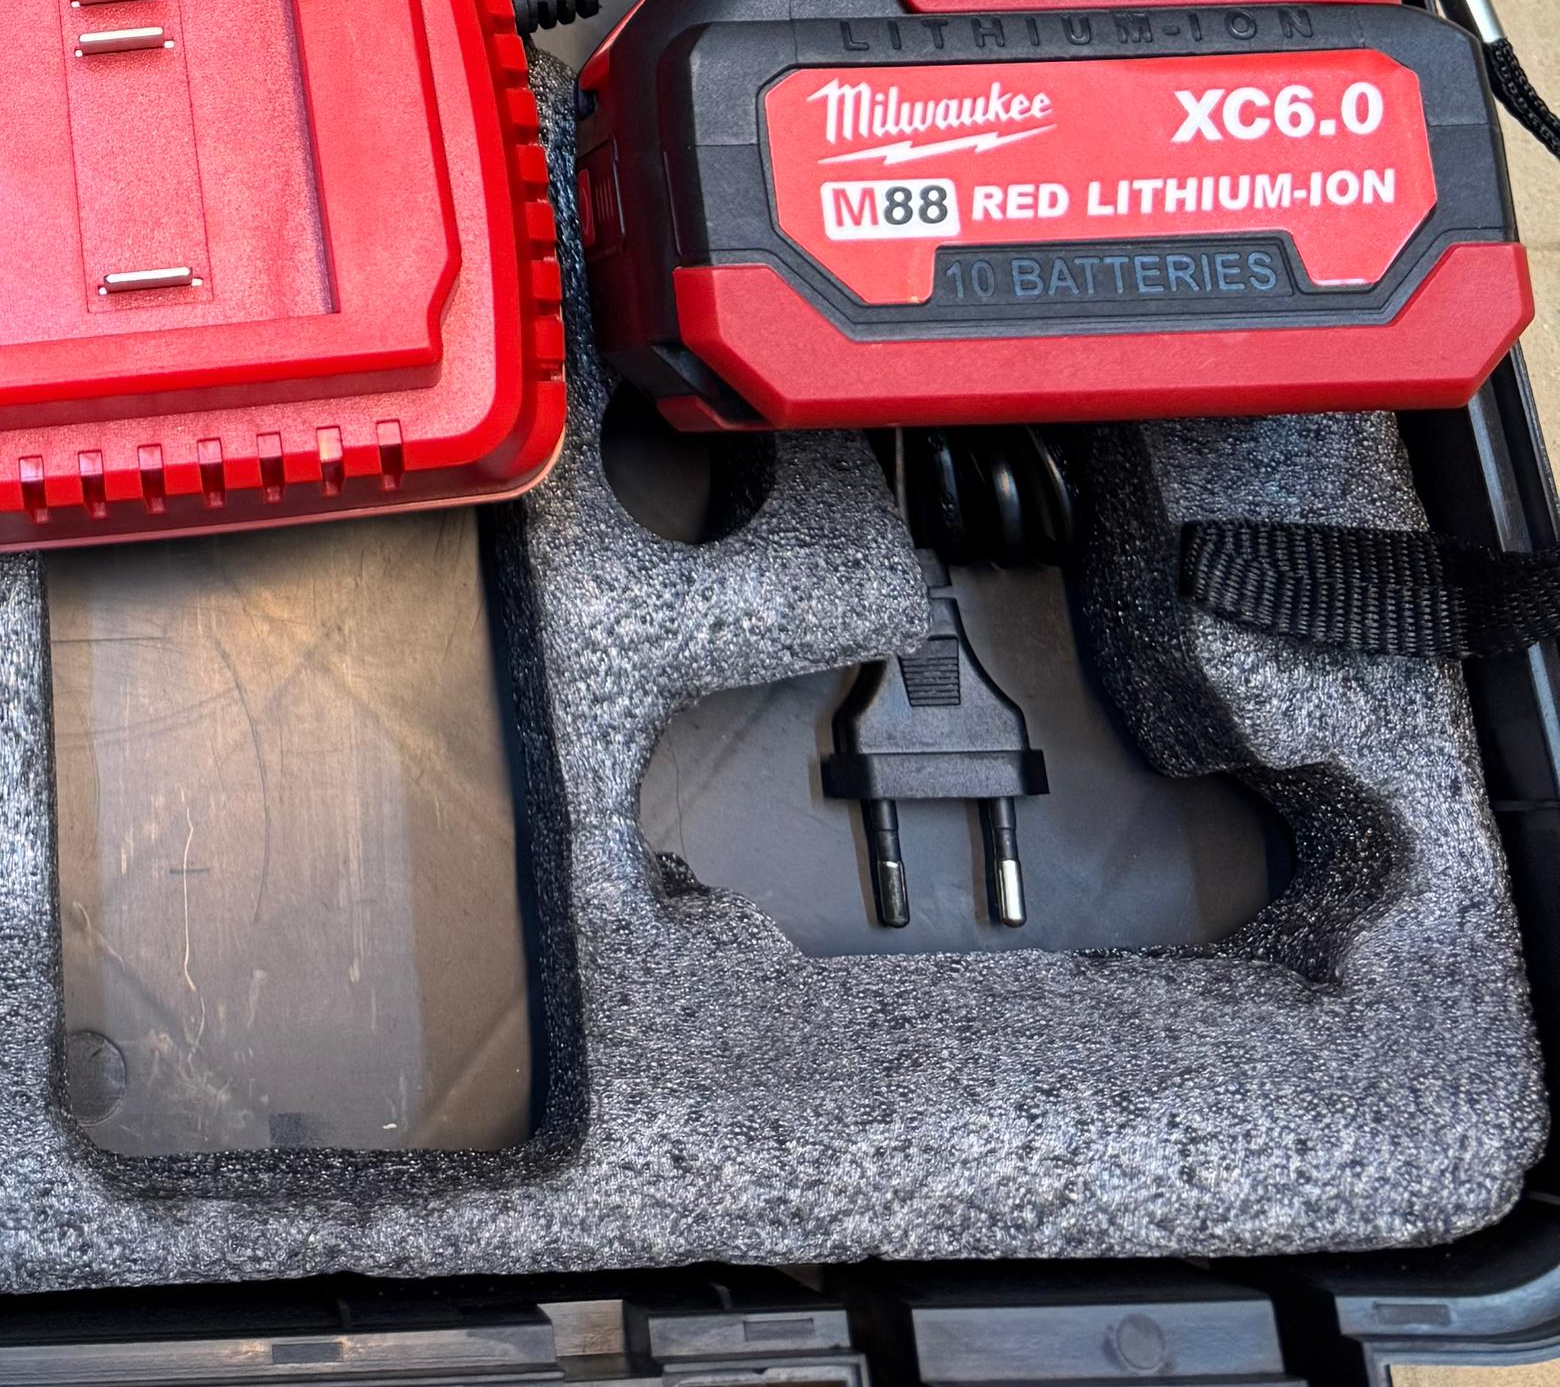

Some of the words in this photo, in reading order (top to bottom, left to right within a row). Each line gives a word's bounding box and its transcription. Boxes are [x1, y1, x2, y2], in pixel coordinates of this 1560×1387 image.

[841, 8, 1316, 52] LITHIUM-ION
[806, 78, 1055, 145] Milwaukee
[1170, 81, 1384, 143] XC6.0
[831, 184, 949, 227] M88
[971, 183, 1070, 221] RED
[1086, 167, 1396, 217] LITHIUM-ION
[945, 259, 995, 300] 10
[1010, 251, 1278, 297] BATTERIES
